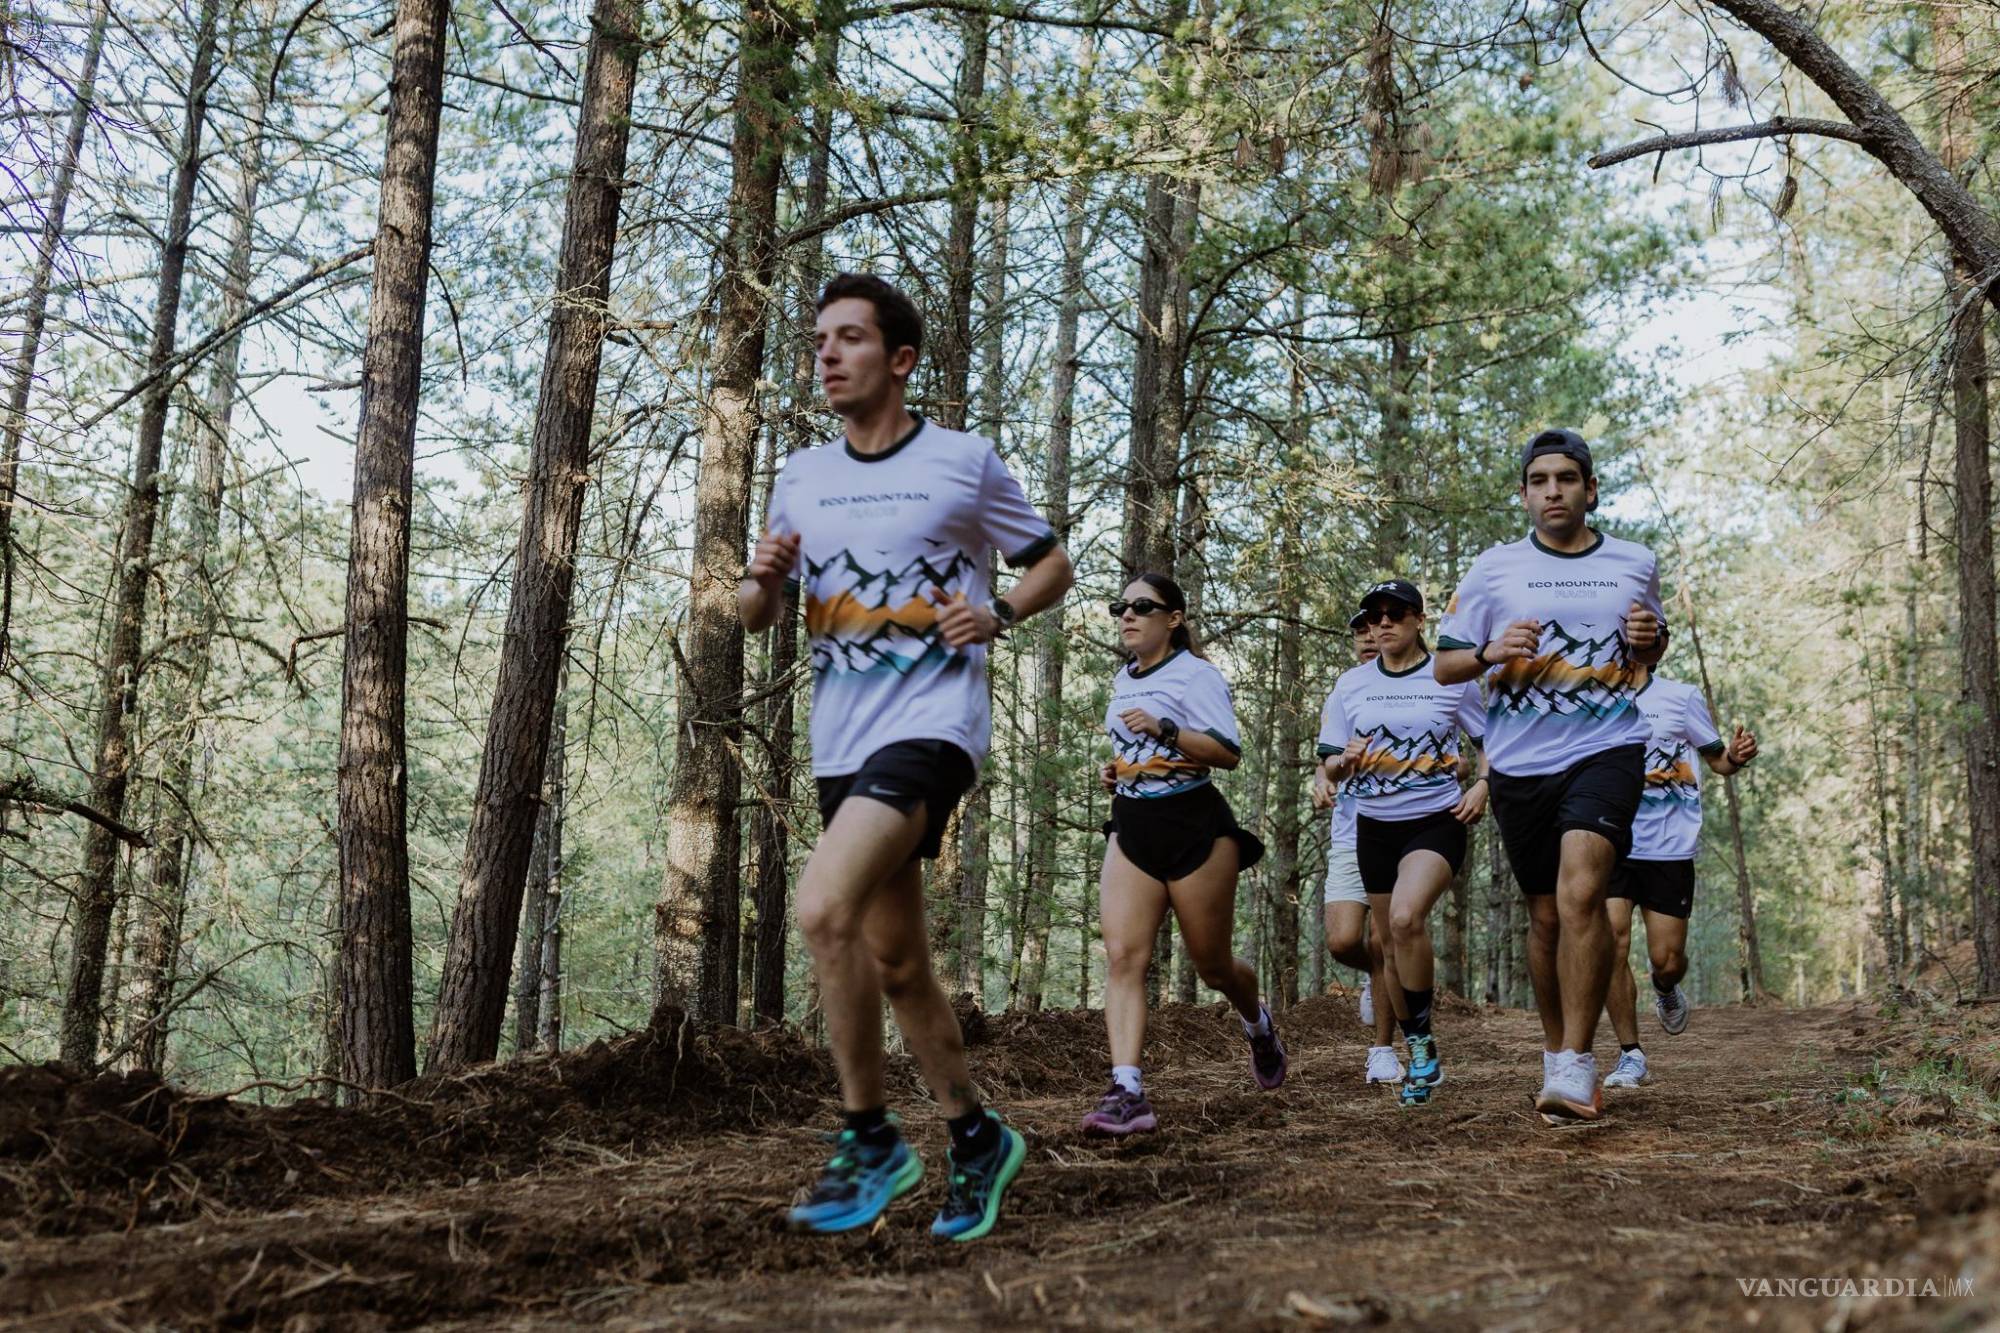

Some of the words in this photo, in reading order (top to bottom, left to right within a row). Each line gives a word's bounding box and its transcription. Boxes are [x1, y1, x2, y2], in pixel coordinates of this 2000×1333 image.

[819, 496, 848, 508] ECO
[850, 493, 930, 504] MOUNTAIN
[1527, 581, 1553, 589] ECO
[1554, 580, 1619, 588] MOUNTAIN
